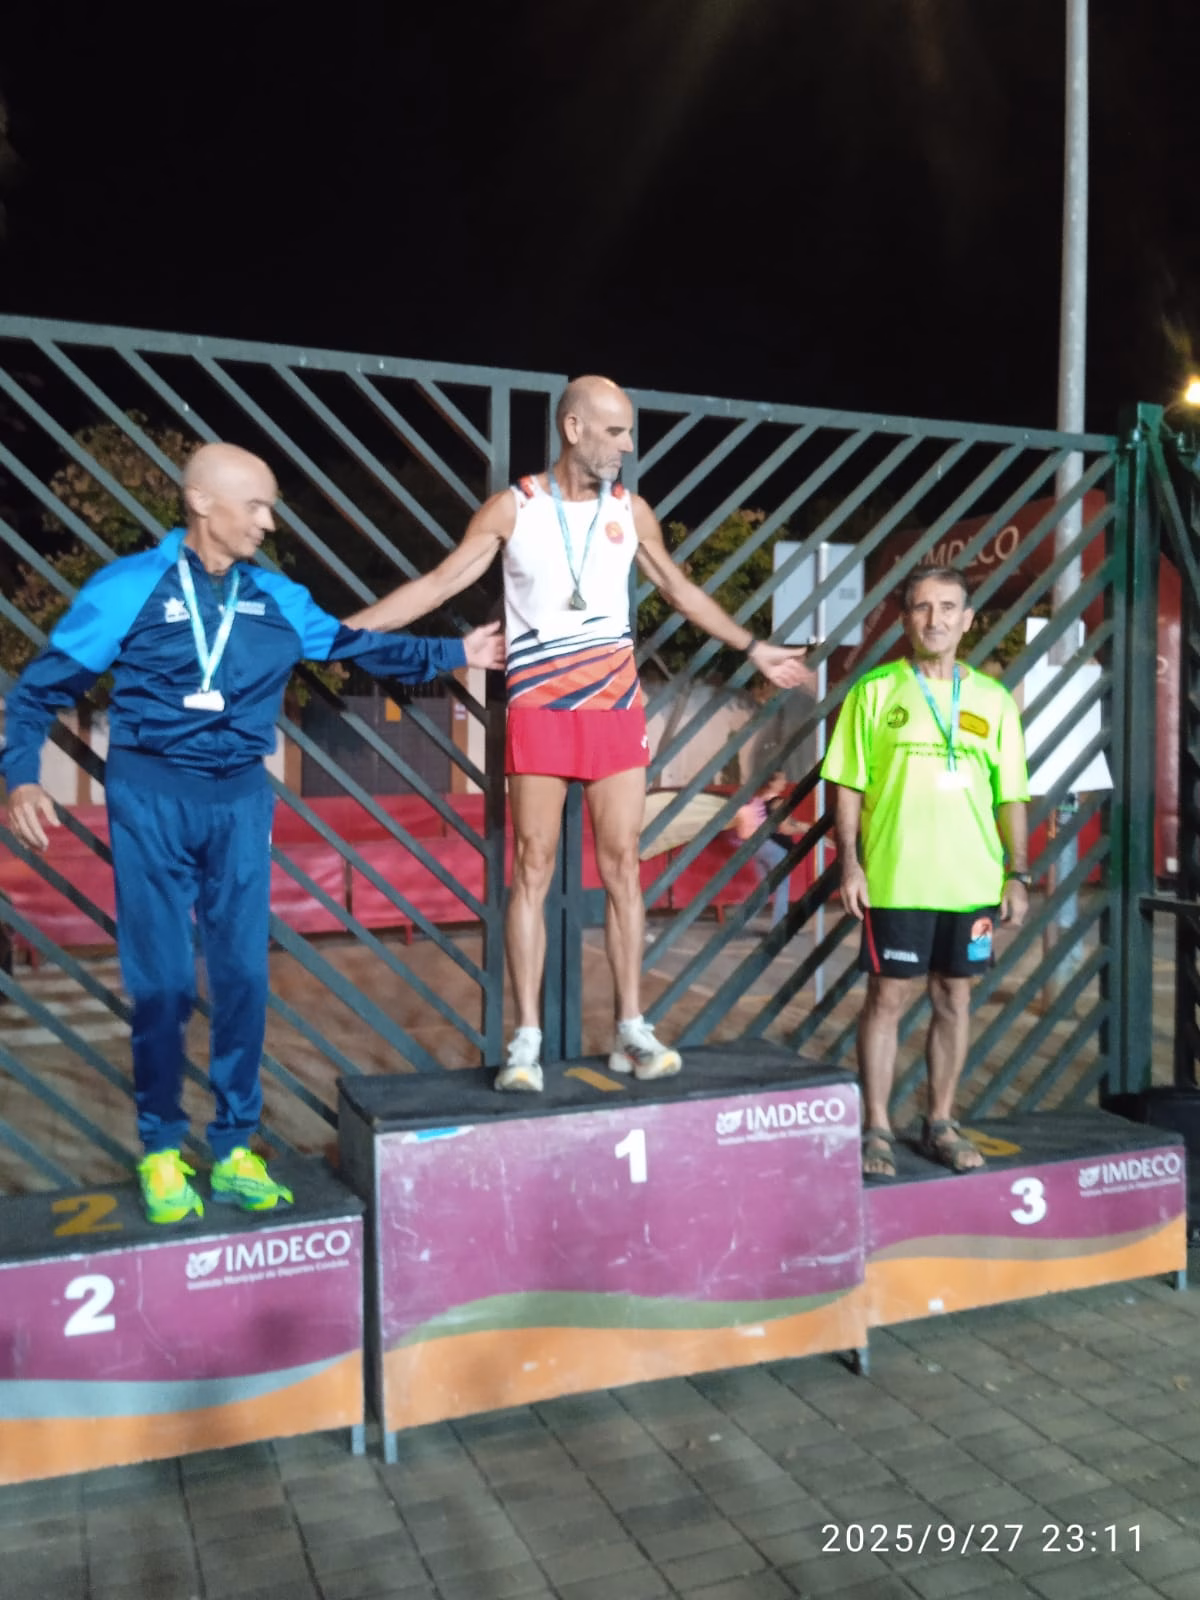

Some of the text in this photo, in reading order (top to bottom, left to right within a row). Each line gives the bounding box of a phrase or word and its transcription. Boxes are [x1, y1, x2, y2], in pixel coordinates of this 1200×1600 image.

[746, 1097, 845, 1131] IMDECO
[614, 1129, 647, 1183] 1
[1102, 1151, 1181, 1185] IMDECO
[52, 1194, 123, 1236] 2
[1010, 1177, 1047, 1224] 3
[225, 1229, 351, 1273] IMDECO
[64, 1274, 115, 1336] 2
